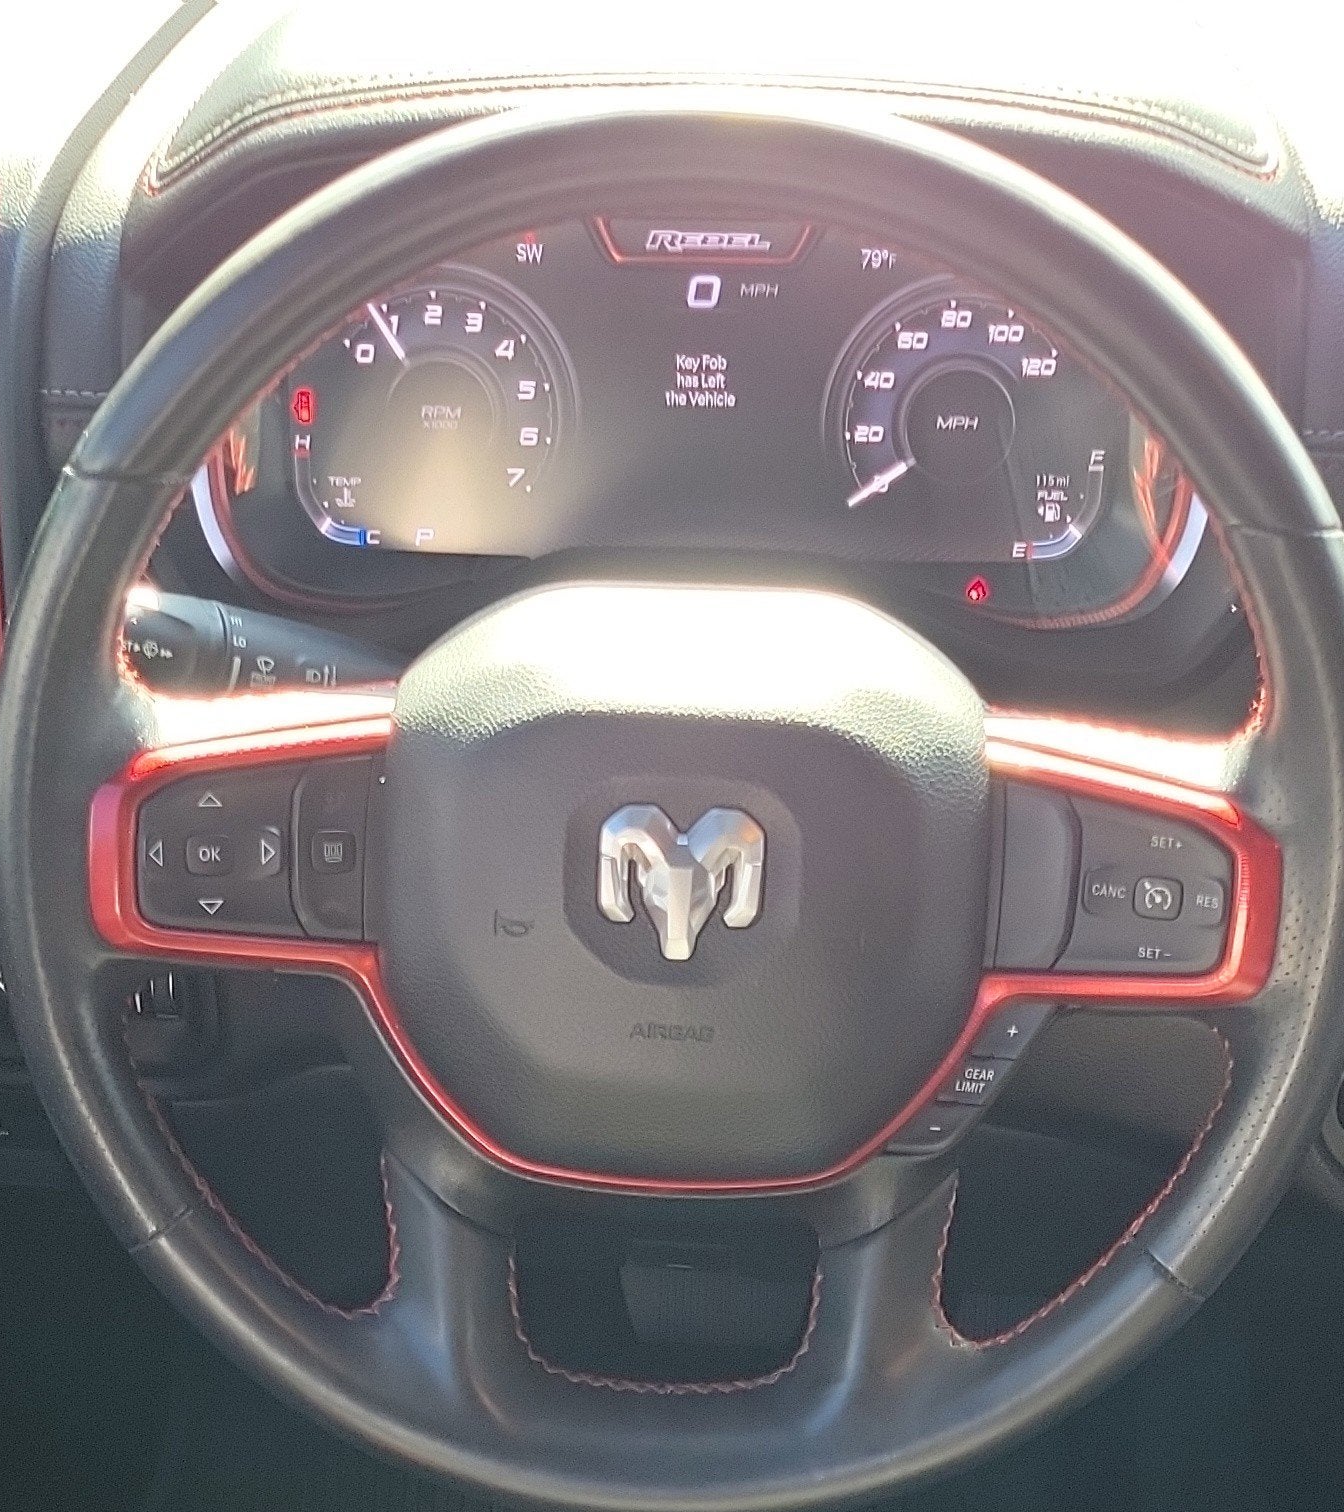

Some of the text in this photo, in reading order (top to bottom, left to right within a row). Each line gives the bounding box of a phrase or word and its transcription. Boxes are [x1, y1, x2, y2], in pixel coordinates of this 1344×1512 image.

[516, 243, 543, 265] SW
[686, 274, 779, 309] 0 MPH
[424, 304, 443, 326] 2
[465, 311, 484, 333] 3
[941, 309, 972, 329] 80
[897, 332, 929, 351] 60
[988, 324, 1024, 343] 100
[356, 343, 376, 364] 0
[494, 339, 516, 361] 4
[675, 353, 728, 372] Key Fob
[1021, 357, 1058, 377] 120
[676, 372, 726, 389] has Left
[863, 370, 895, 391] 40
[517, 380, 538, 401] 5
[665, 390, 736, 407] the Vehicle
[420, 404, 462, 421] RPM
[936, 415, 979, 431] MPH
[294, 434, 311, 452] H
[519, 427, 538, 446] 6
[853, 425, 884, 444] 20
[1088, 449, 1105, 465] F
[328, 475, 362, 488] TEMP
[506, 467, 527, 488] 7
[414, 528, 436, 547] P
[1012, 543, 1027, 559] E
[199, 847, 221, 863] OK
[1092, 884, 1126, 900] CANC
[1196, 895, 1219, 909] RES
[964, 1067, 995, 1082] GEAR
[955, 1079, 986, 1094] LIMIT
